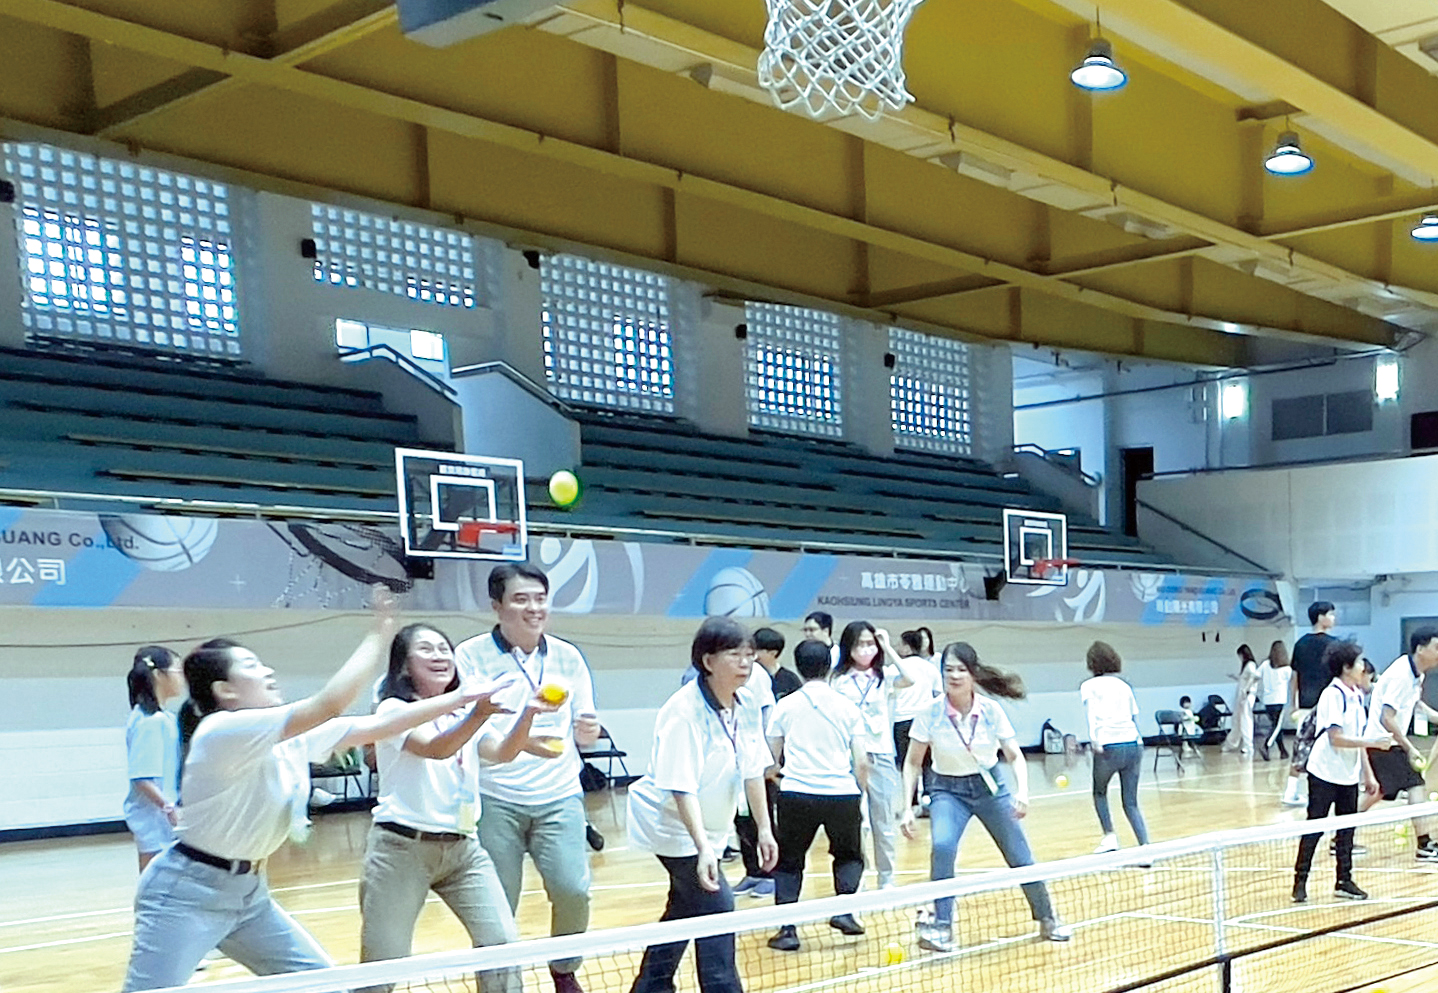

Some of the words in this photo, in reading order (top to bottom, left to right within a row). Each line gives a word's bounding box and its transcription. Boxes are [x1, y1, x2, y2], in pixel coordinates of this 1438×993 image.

[0, 529, 61, 546] UANG
[0, 557, 66, 585] 公司
[904, 598, 937, 608] SPORTS
